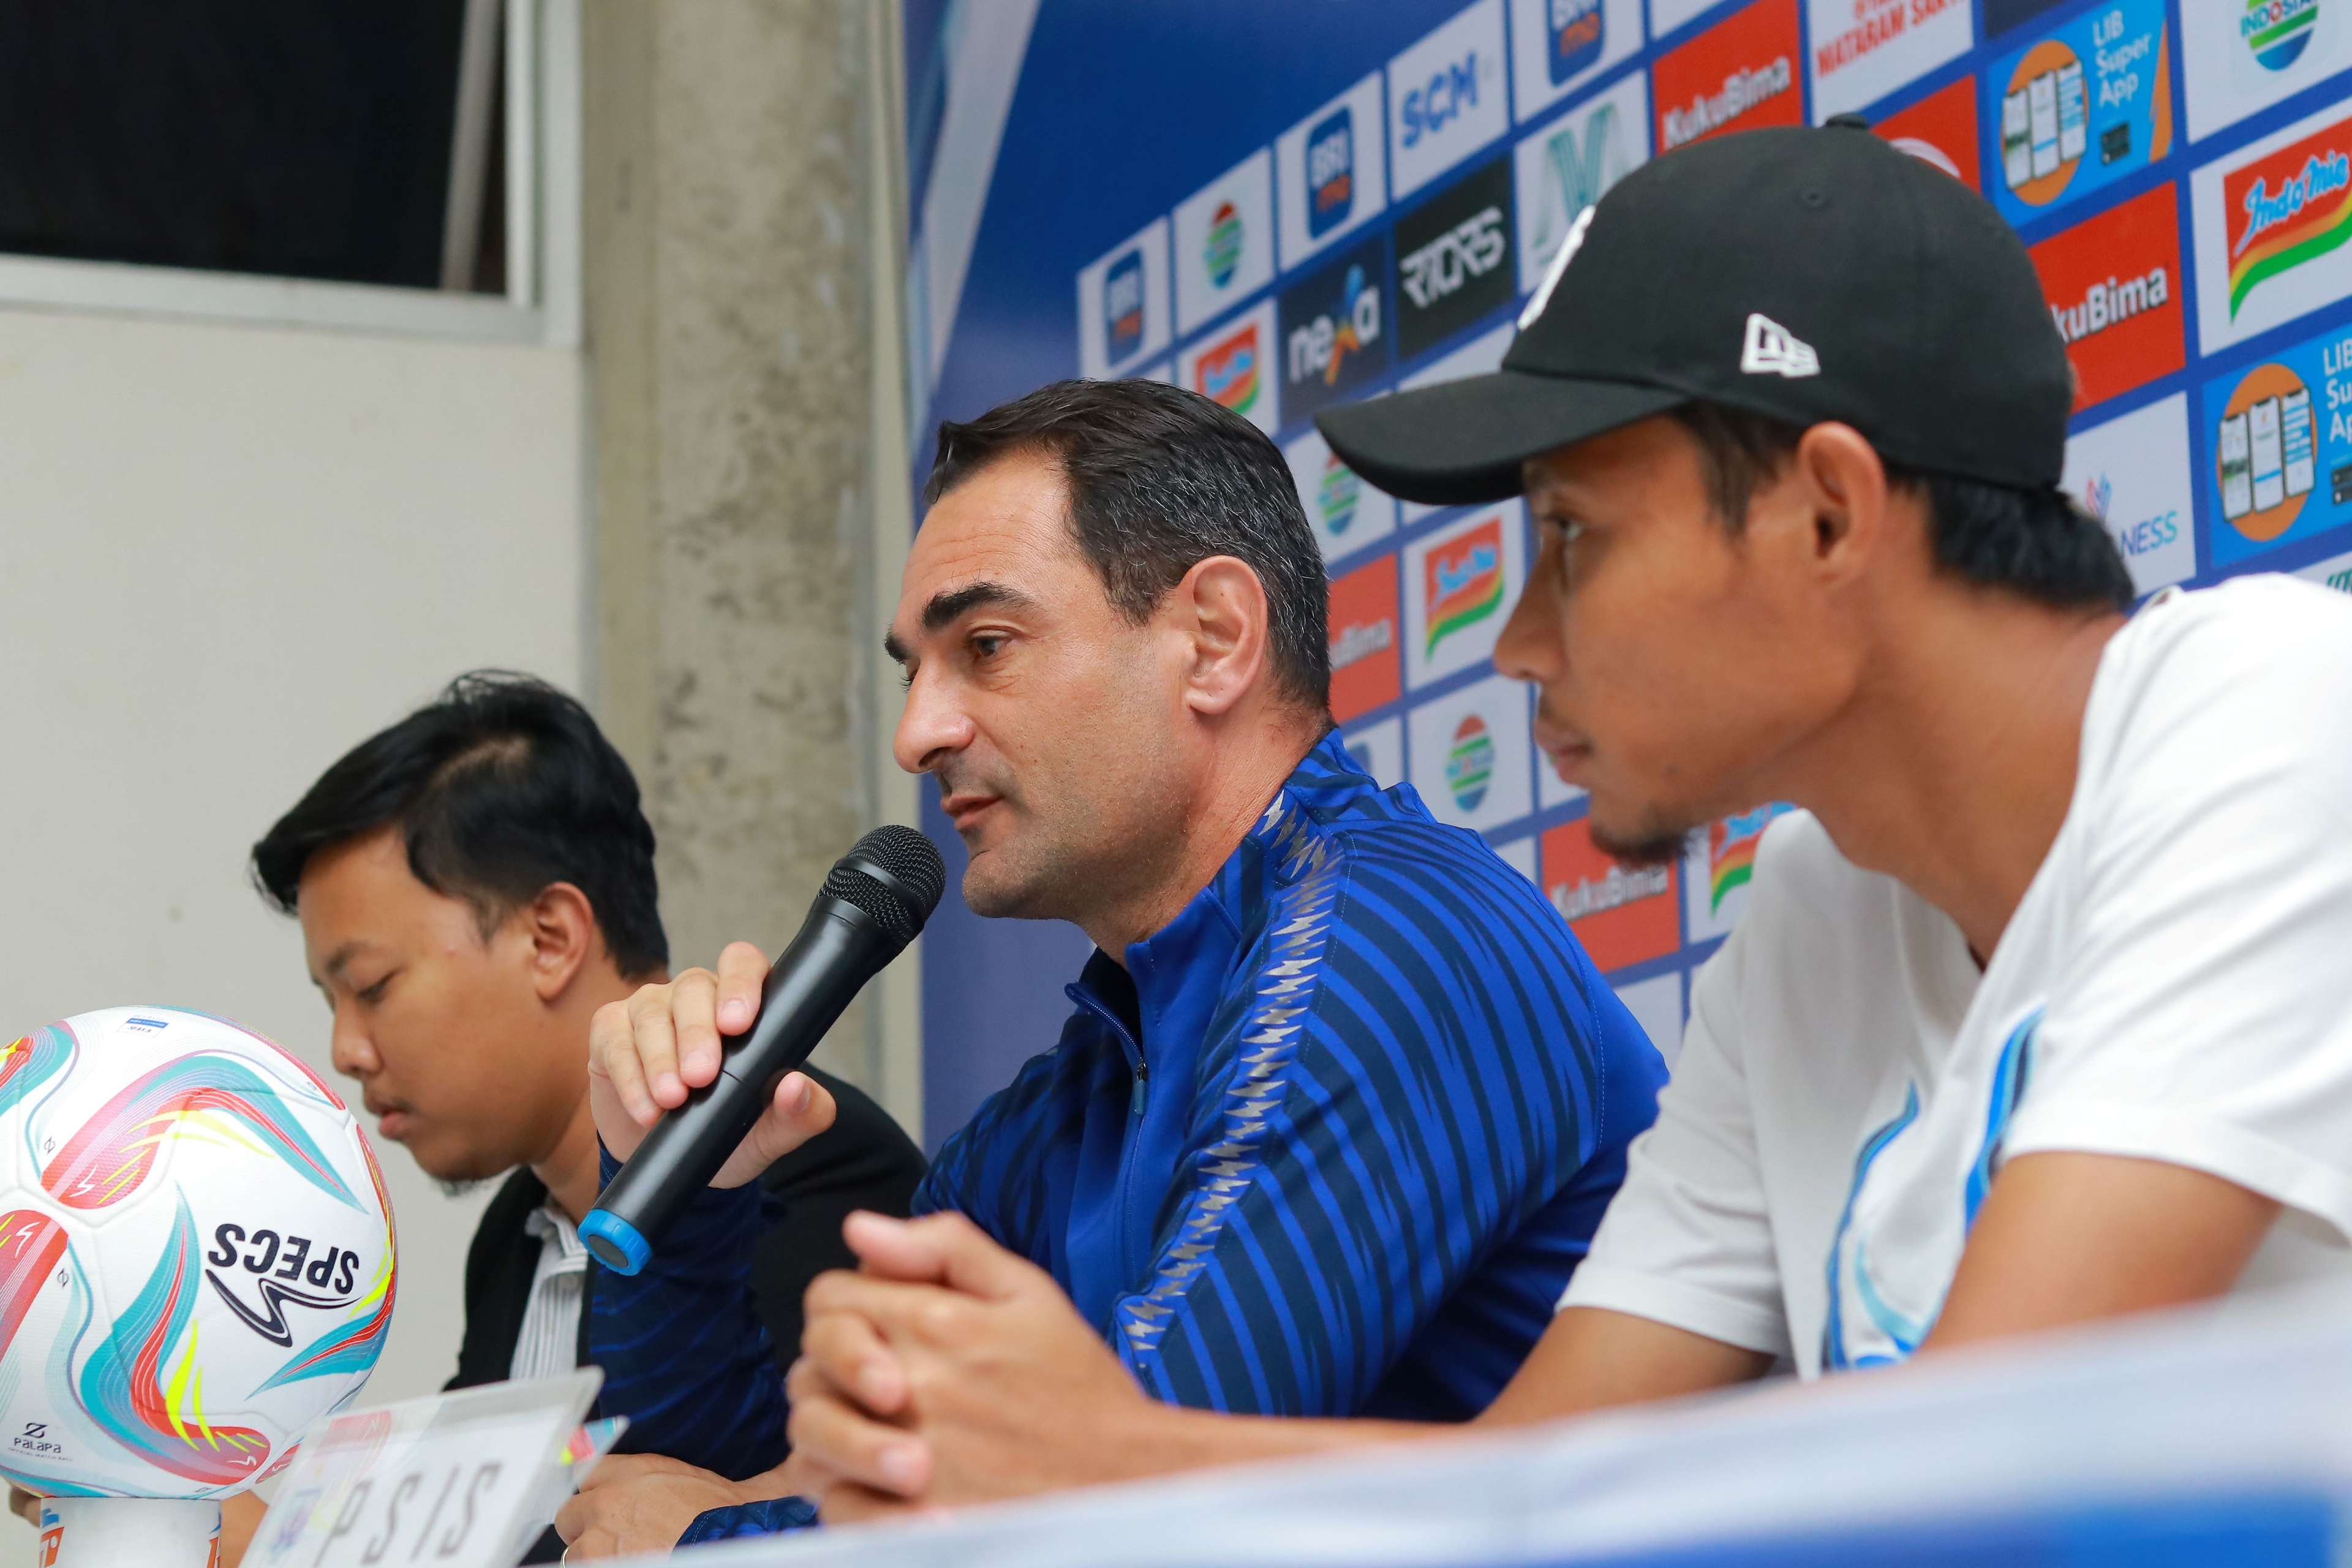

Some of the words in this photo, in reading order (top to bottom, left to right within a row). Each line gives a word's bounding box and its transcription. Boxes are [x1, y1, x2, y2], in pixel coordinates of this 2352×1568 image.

[2092, 10, 2124, 47] LIB
[2096, 33, 2151, 77] Super
[1402, 51, 1478, 149] SCM
[1664, 55, 1790, 149] KukuBima
[2098, 72, 2139, 107] App
[2051, 267, 2169, 345] kuBima
[2120, 510, 2177, 557] NESS
[208, 1223, 360, 1294] SPECS
[312, 1460, 505, 1568] PSIS
